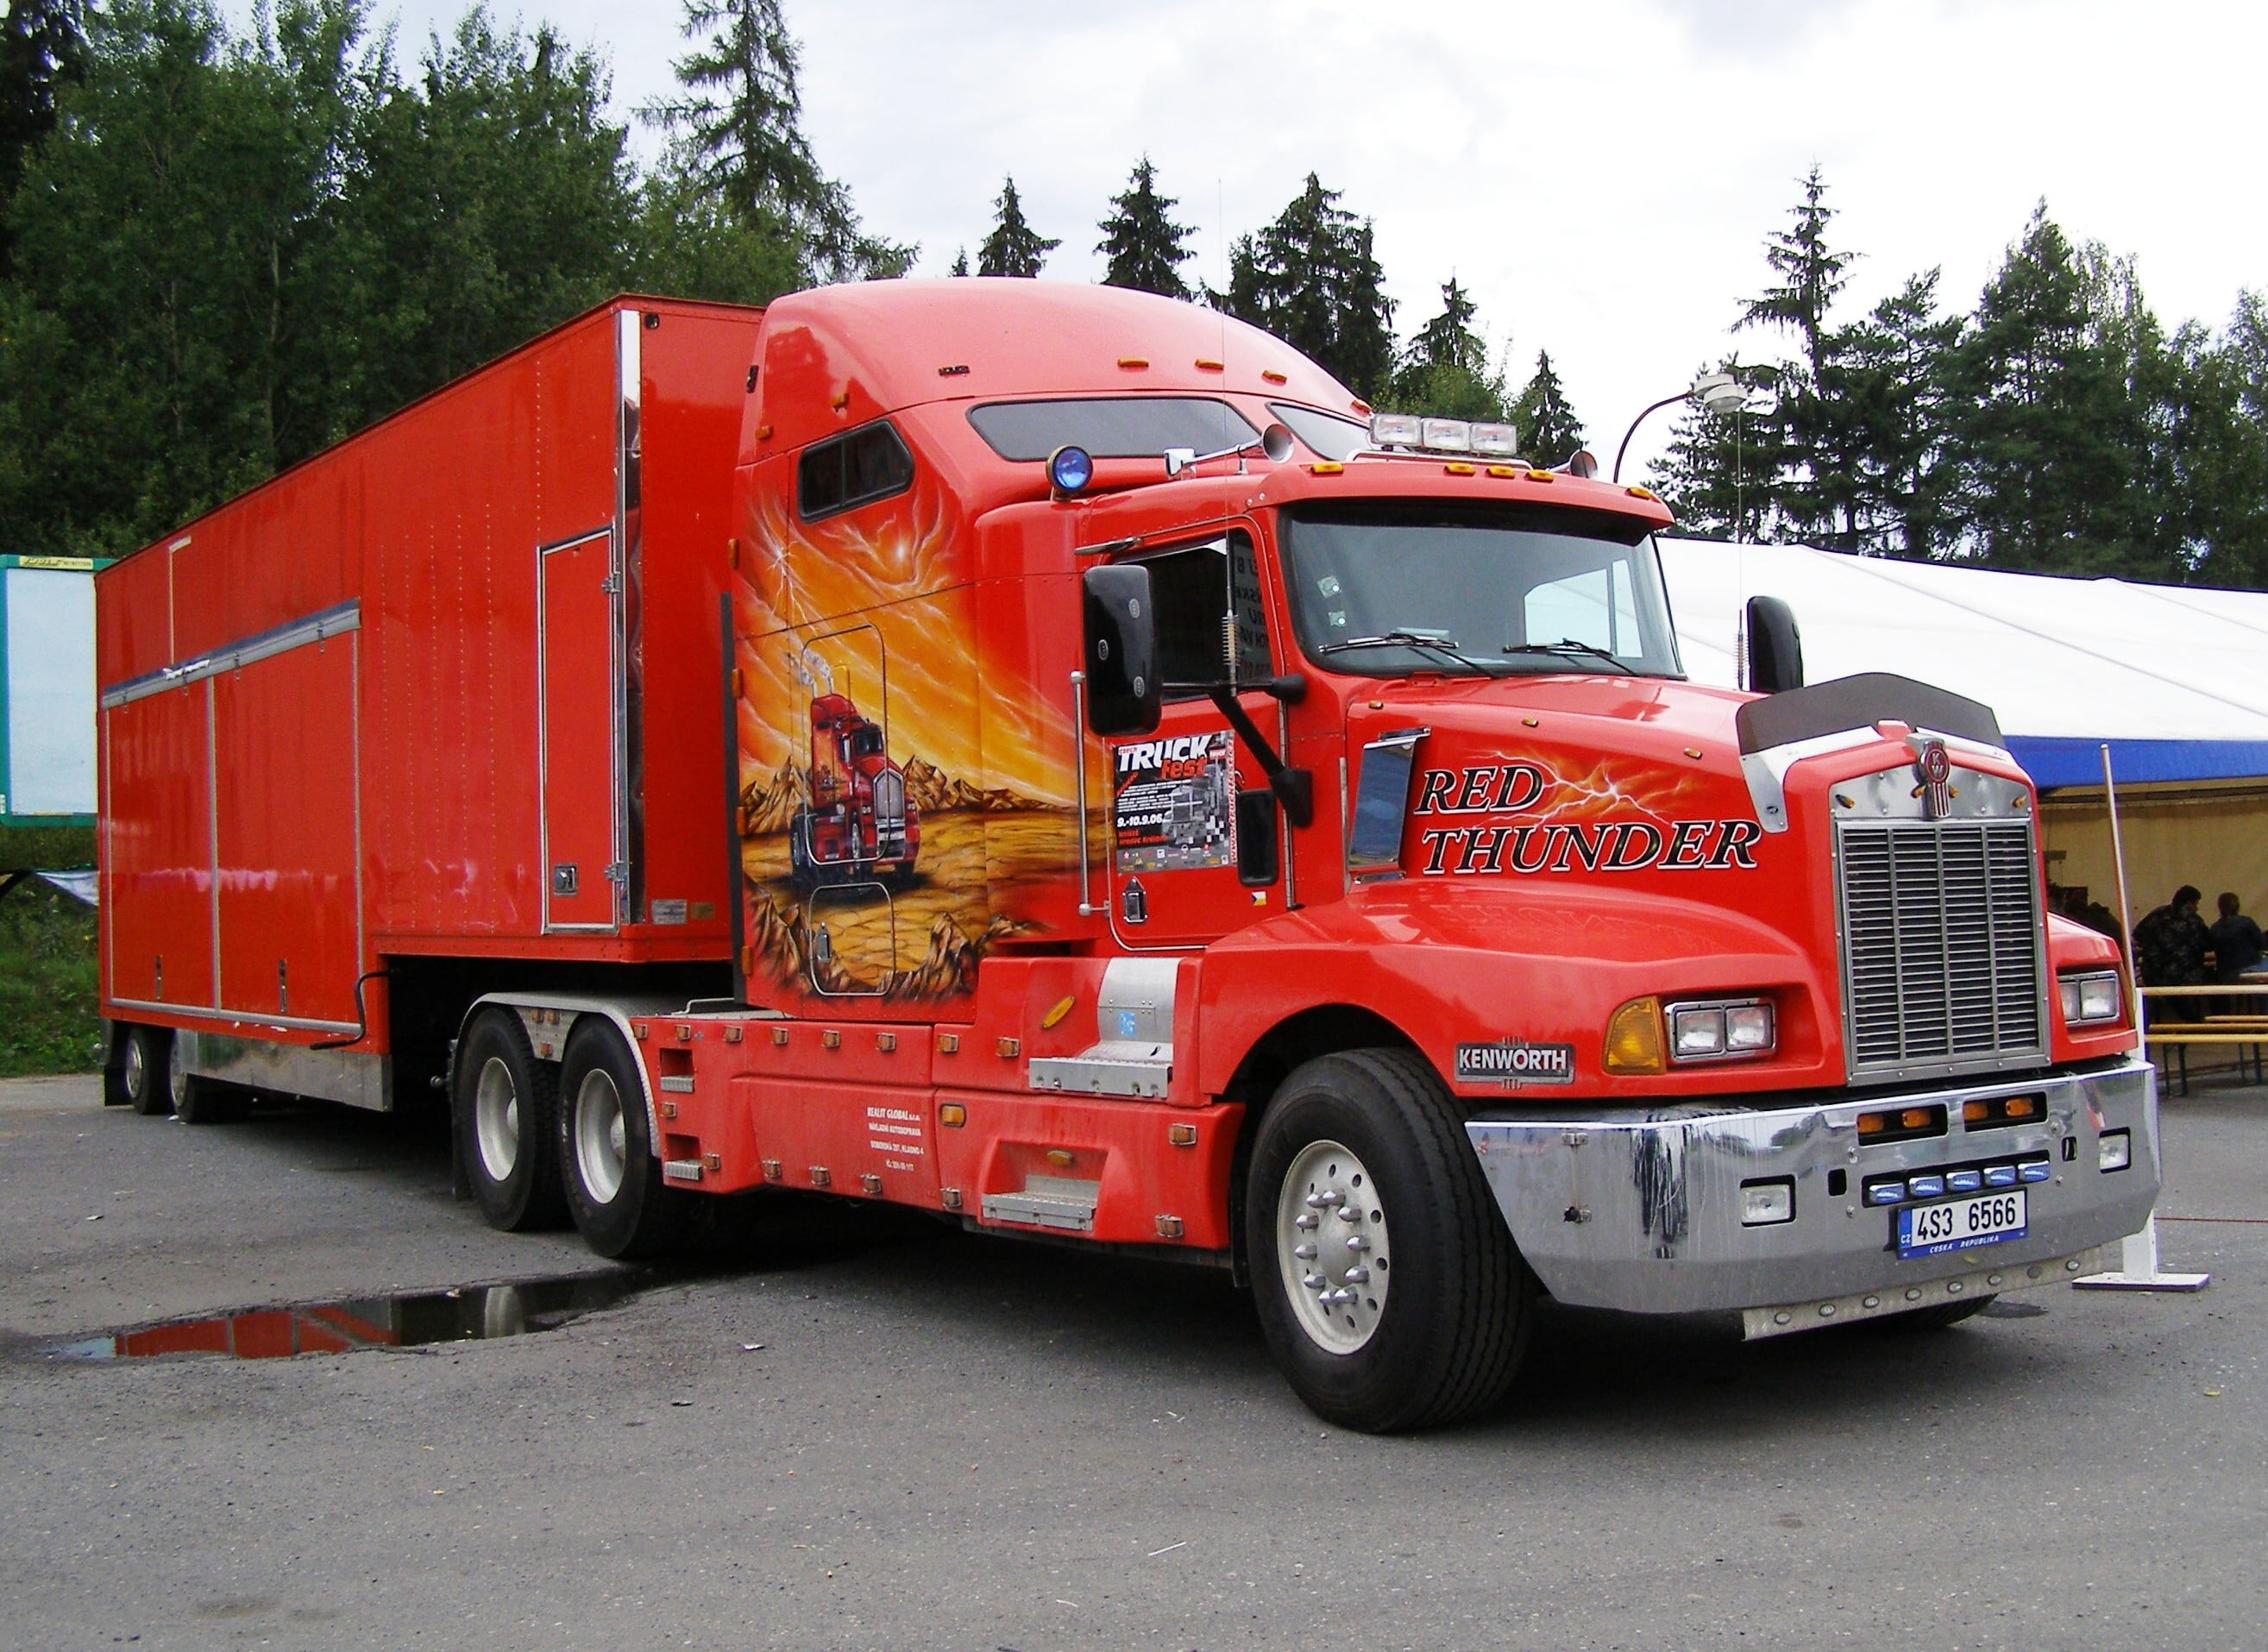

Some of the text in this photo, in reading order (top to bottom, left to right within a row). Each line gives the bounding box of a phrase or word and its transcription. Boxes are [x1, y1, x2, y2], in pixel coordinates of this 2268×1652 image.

[1118, 734, 1213, 772] TRUCK
[1159, 756, 1207, 780] fest
[1414, 765, 1545, 816] RED
[1422, 820, 1762, 875] THUNDER
[1459, 1048, 1567, 1071] KENWORTH
[867, 1107, 886, 1119] REALIT
[886, 1109, 908, 1121] GLOBAL
[1917, 1197, 2016, 1241] 4S3 6566
[1900, 1234, 1911, 1244] CZ
